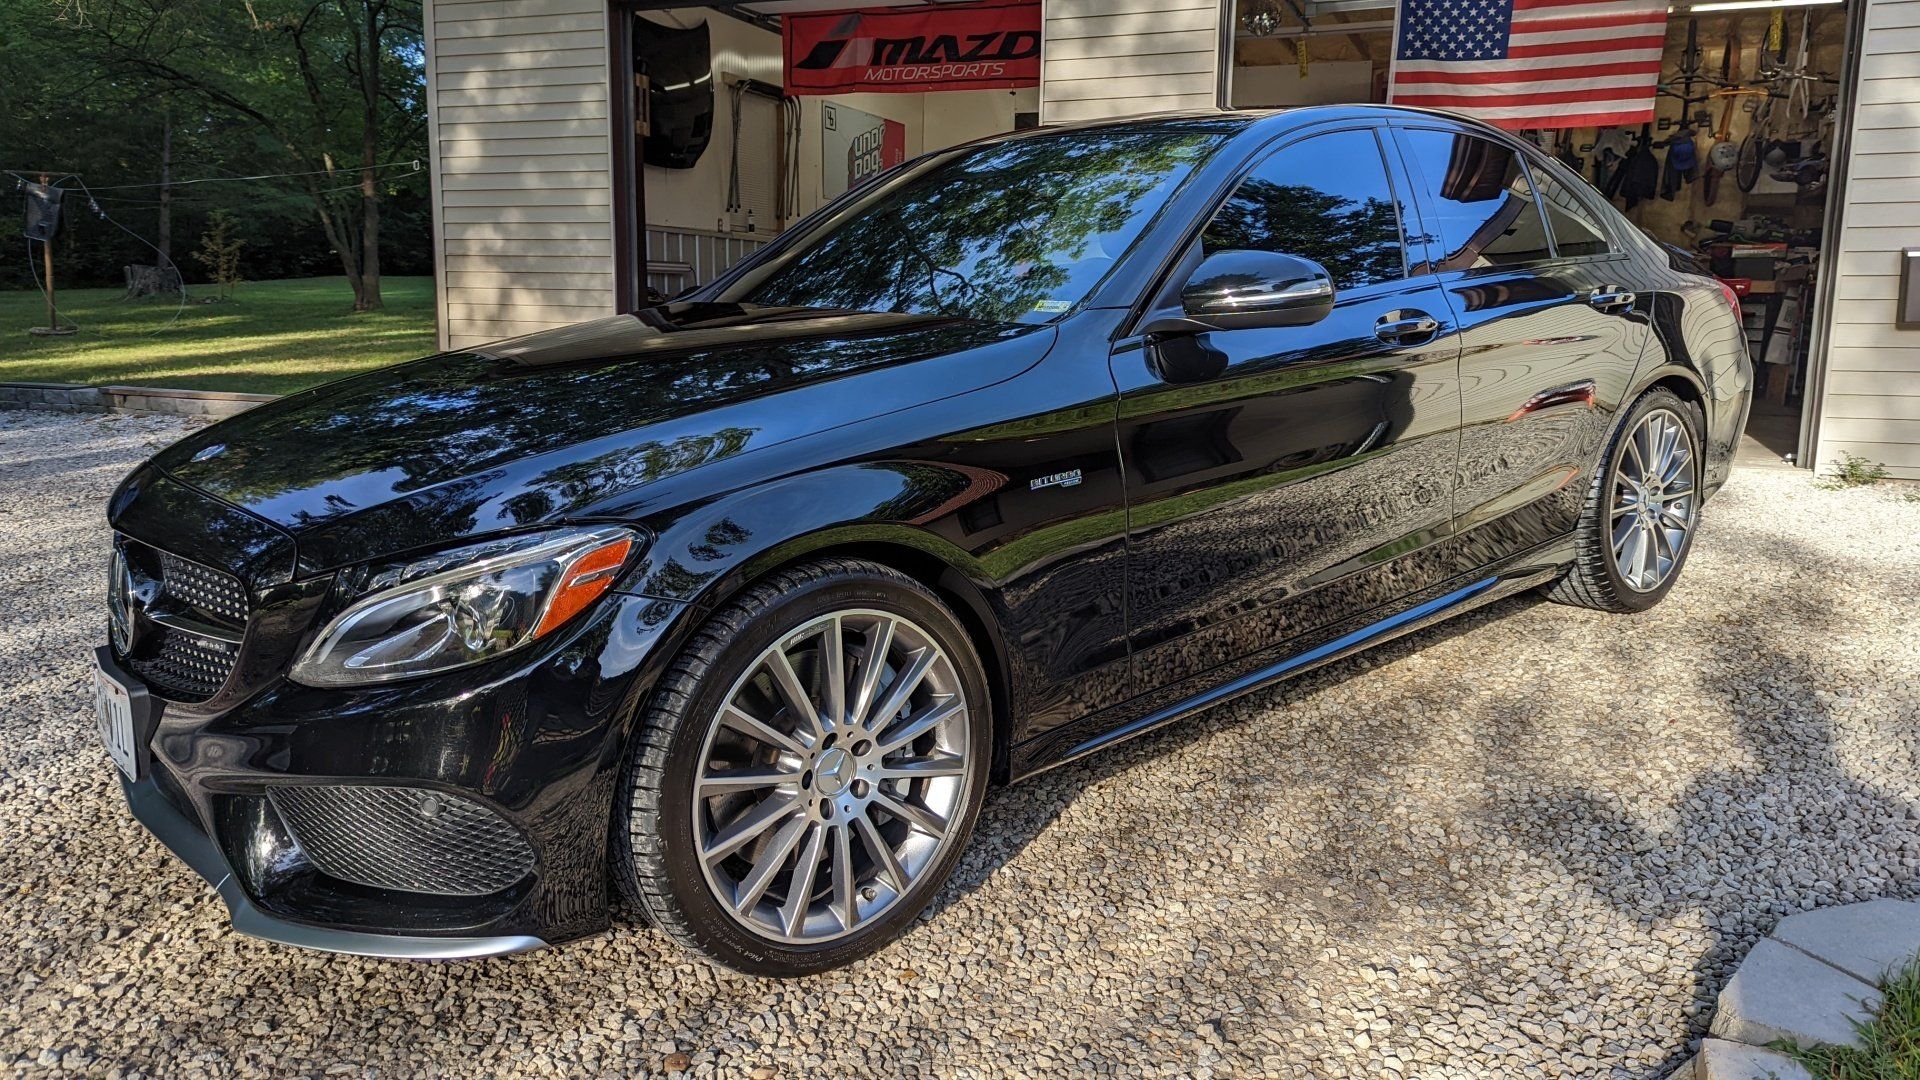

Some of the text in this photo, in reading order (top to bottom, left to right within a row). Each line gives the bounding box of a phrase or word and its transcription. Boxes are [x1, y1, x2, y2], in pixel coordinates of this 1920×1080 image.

[869, 31, 1041, 66] MAZD
[864, 62, 1006, 81] MOTORSPORTS
[722, 936, 744, 953] Sport
[744, 950, 763, 962] Pilot
